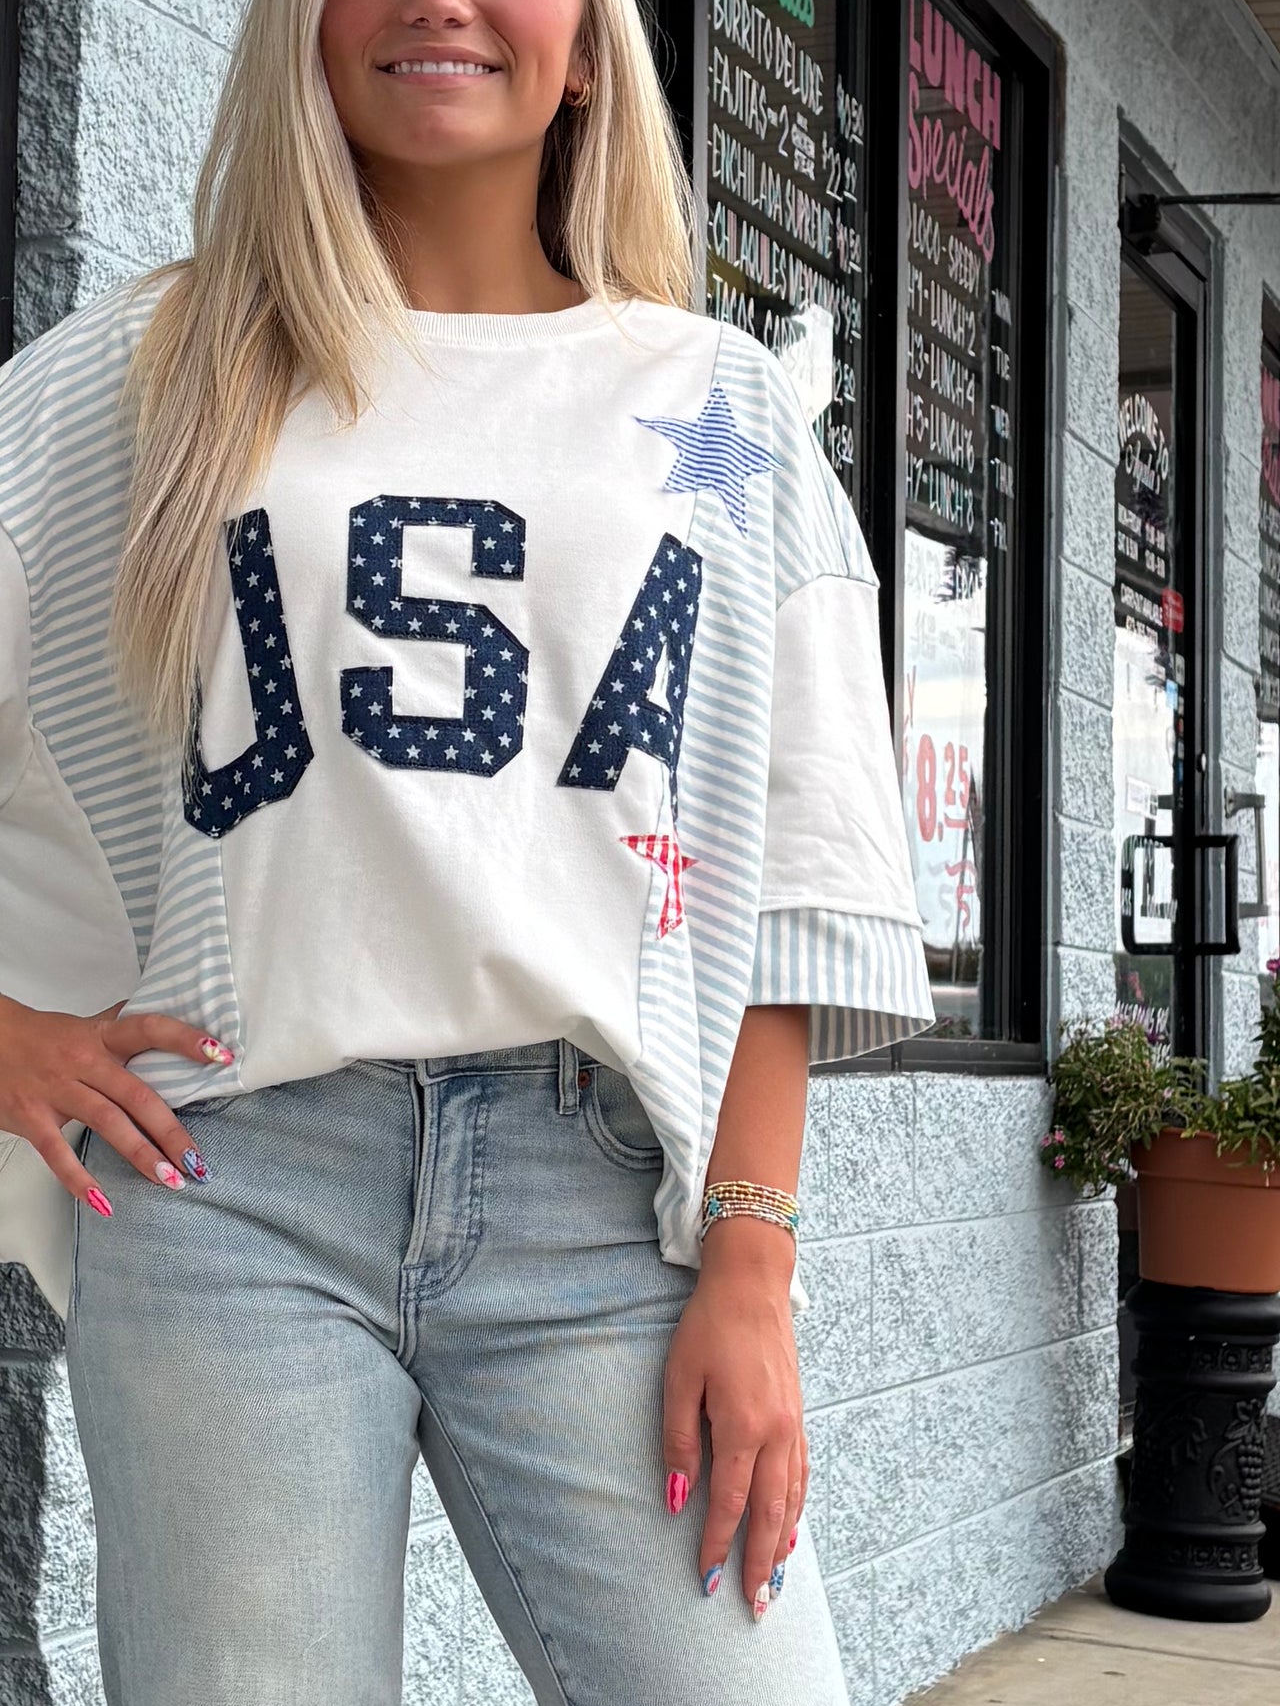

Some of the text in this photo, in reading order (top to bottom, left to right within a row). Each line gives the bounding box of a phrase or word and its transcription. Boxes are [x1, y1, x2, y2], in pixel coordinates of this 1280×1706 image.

[712, 45, 767, 141] FAJITAS
[775, 26, 824, 116] DELUXE
[907, 70, 995, 264] Specials
[183, 493, 704, 840] USA
